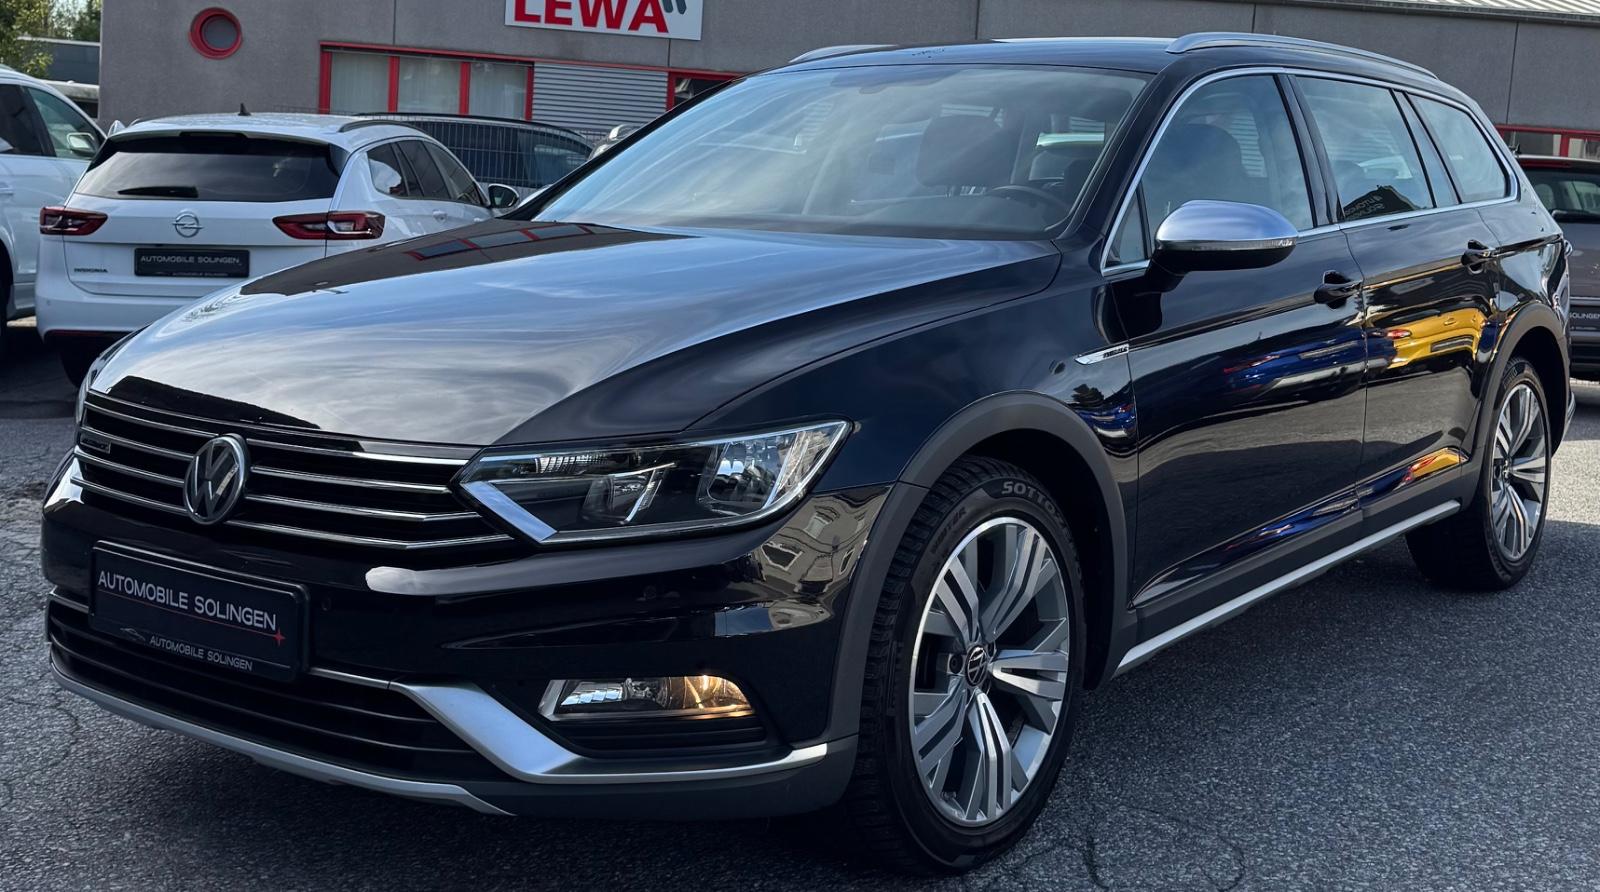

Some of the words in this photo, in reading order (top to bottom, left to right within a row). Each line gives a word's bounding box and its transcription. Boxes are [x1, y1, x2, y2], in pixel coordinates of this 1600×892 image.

[514, 0, 669, 34] LEWA
[140, 255, 195, 264] AUTOMOBILE
[197, 255, 240, 265] SOLINGEN
[98, 570, 189, 610] AUTOMOBILE
[194, 596, 277, 631] SOLINGEN
[149, 634, 204, 660] AUTOMOBILE
[206, 650, 253, 672] SOLINGEN
